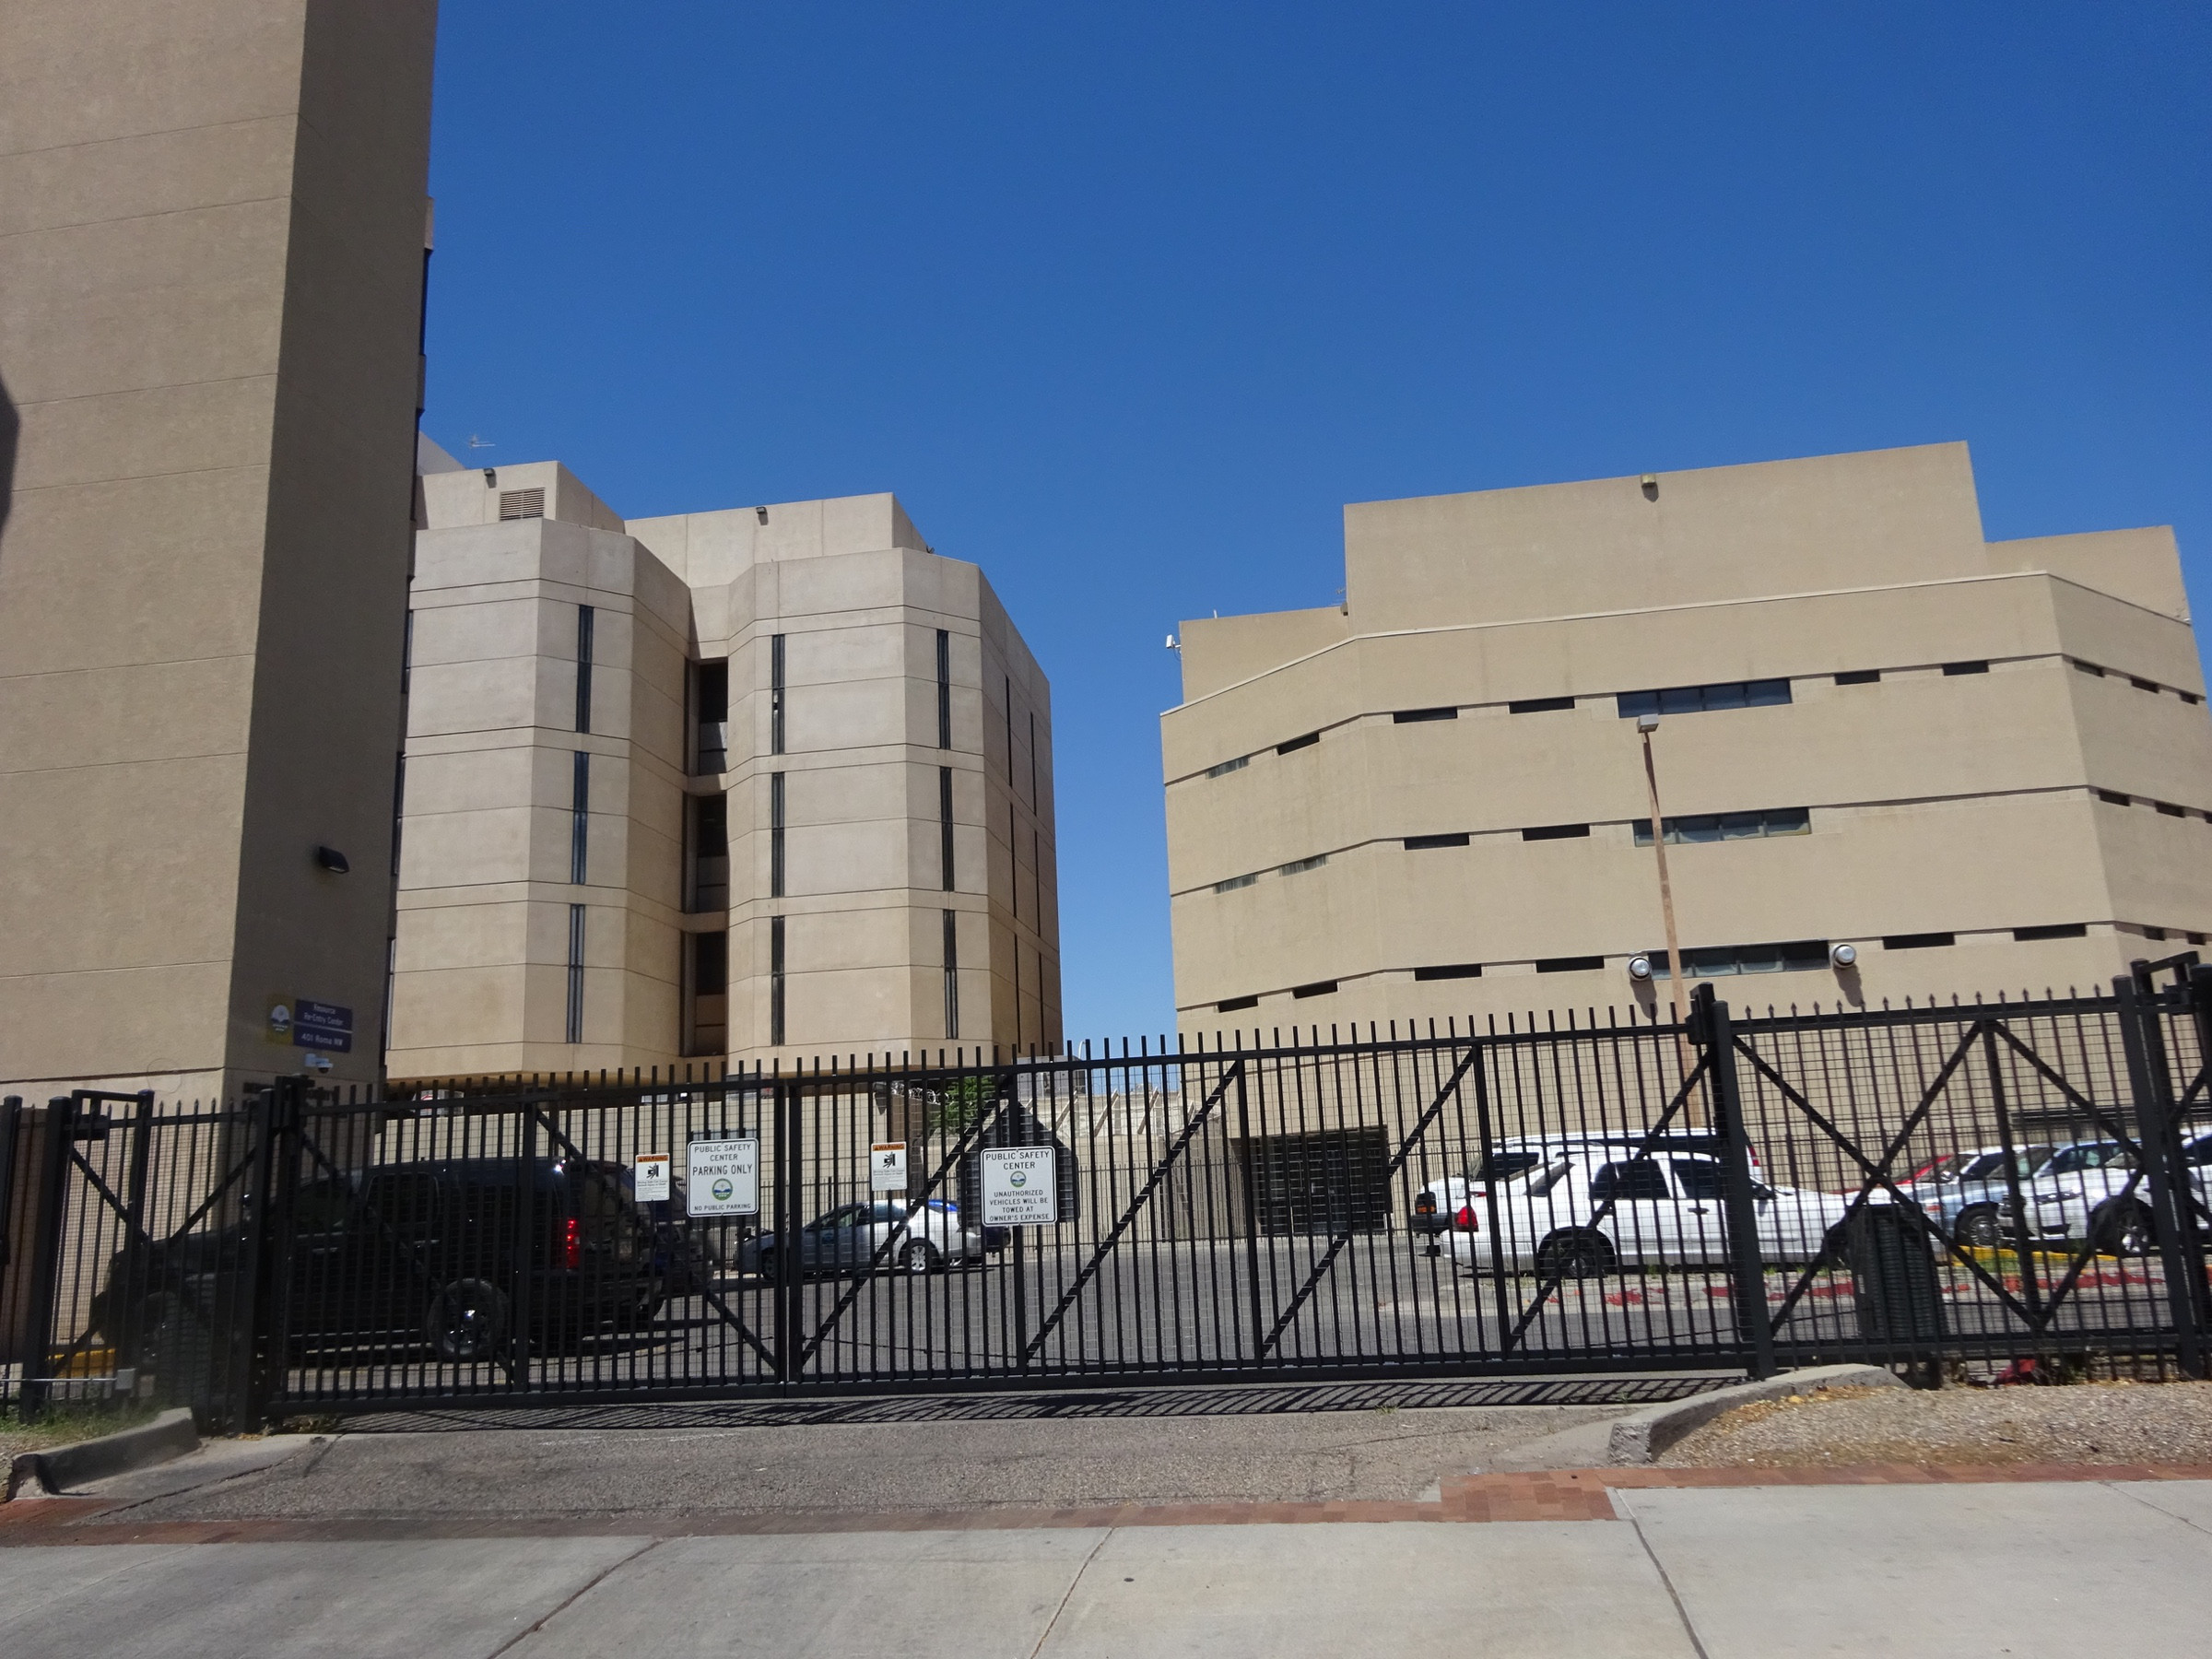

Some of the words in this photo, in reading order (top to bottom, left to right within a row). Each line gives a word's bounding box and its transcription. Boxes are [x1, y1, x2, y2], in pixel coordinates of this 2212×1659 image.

[985, 1152, 1016, 1160] PUBLIC
[1019, 1151, 1050, 1159] SAFETY
[692, 1165, 728, 1176] PARKING
[731, 1164, 753, 1174] ONLY
[1004, 1161, 1035, 1170] CENTER
[994, 1189, 1043, 1197] UNAUTHORIZED
